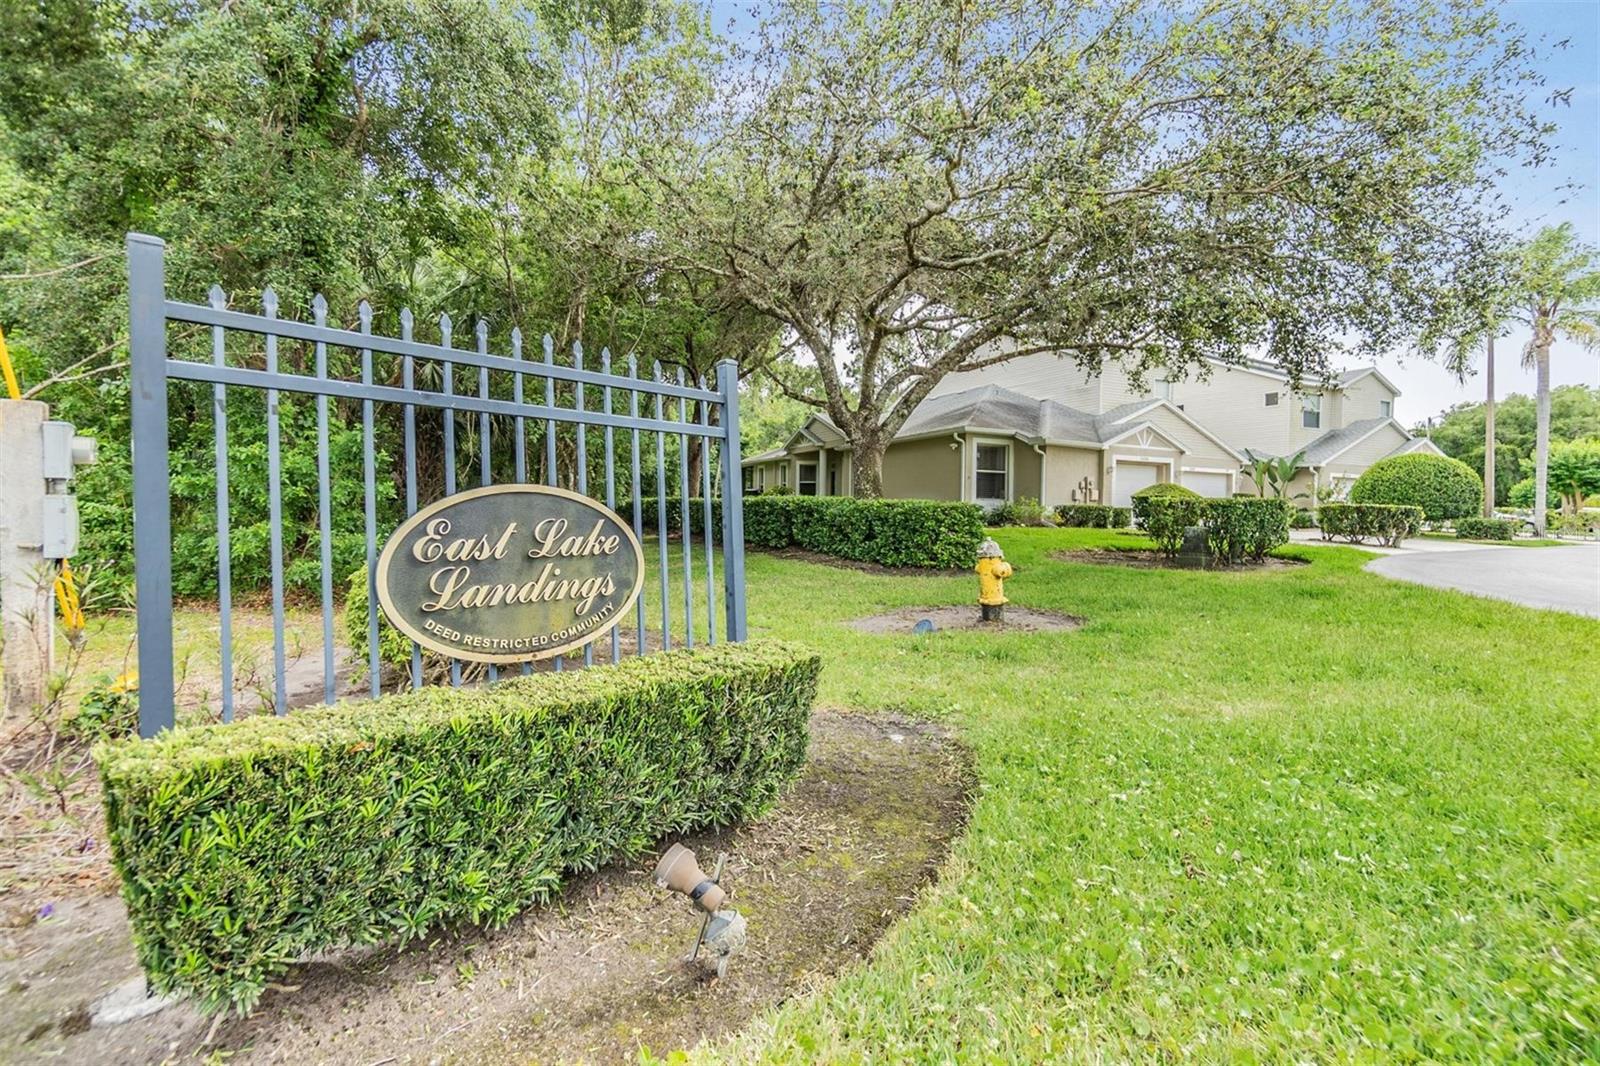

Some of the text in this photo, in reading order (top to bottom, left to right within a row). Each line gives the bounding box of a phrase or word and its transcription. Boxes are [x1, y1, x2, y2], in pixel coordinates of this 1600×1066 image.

[412, 518, 620, 563] East Lake
[421, 562, 616, 616] Landings
[424, 602, 615, 649] DEED RESTRICTED COMMUNITY
